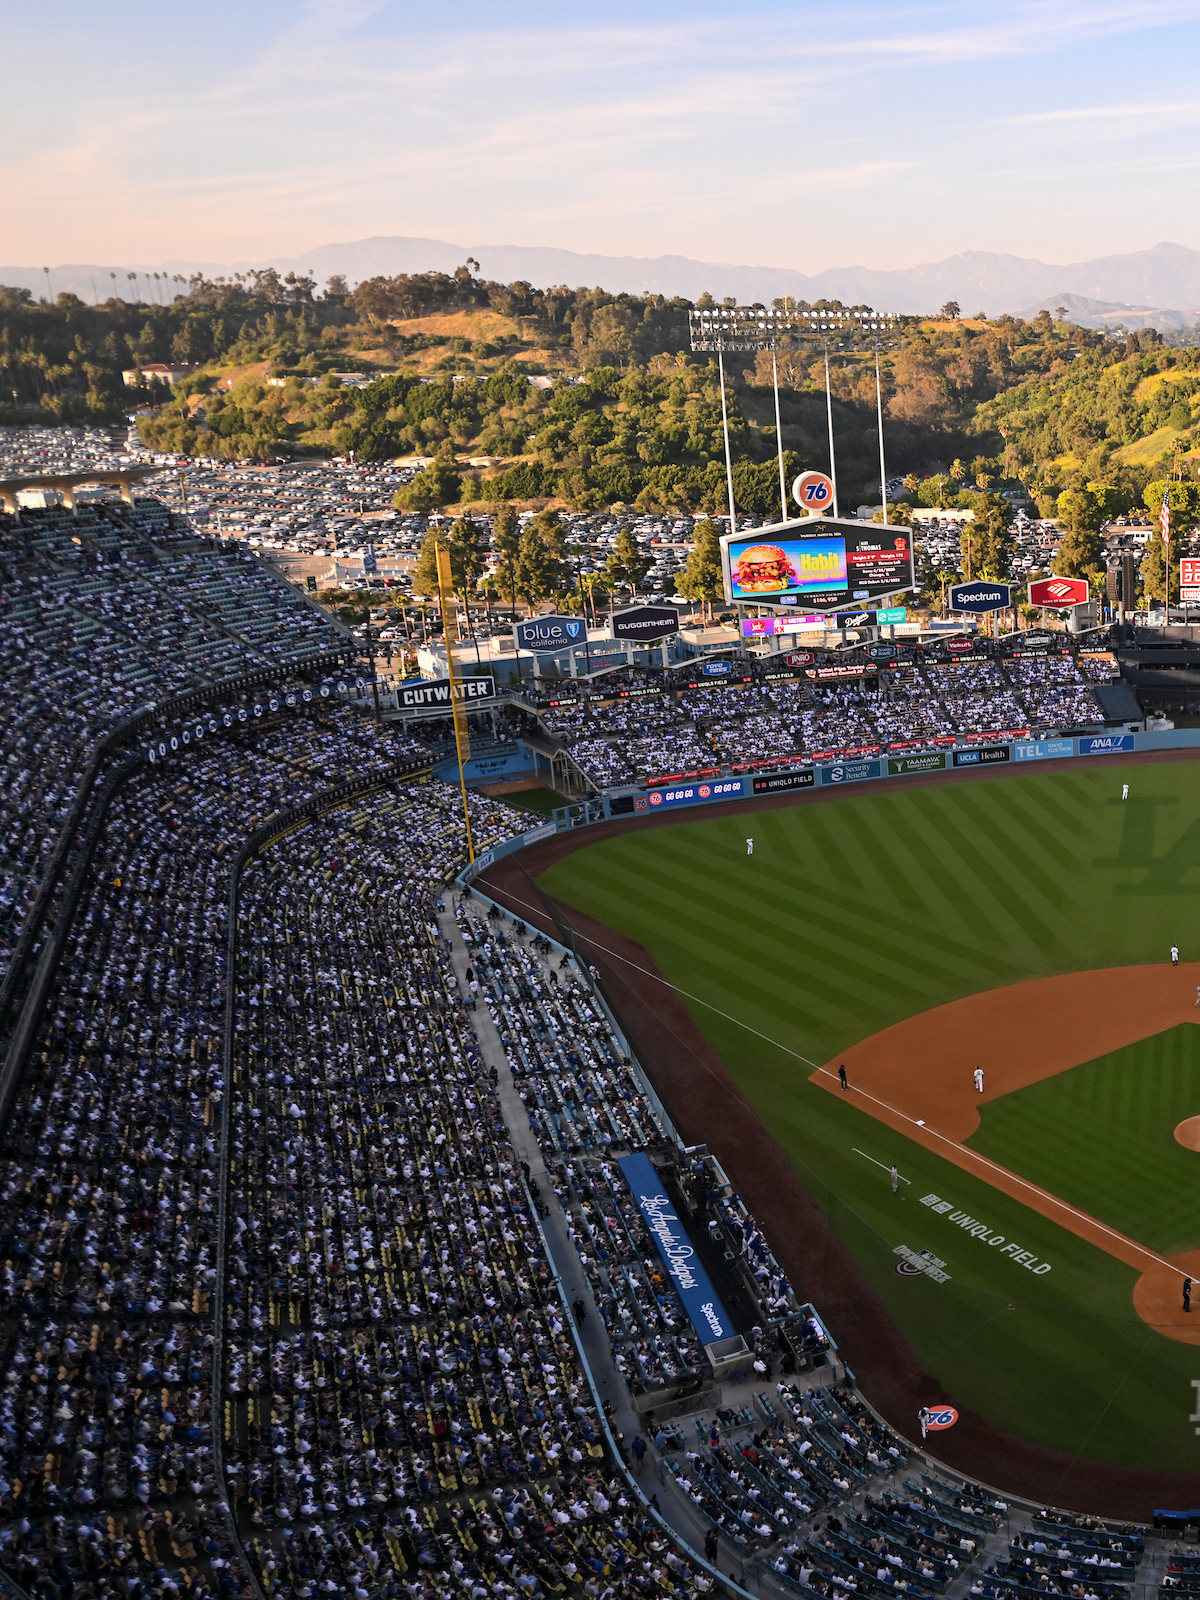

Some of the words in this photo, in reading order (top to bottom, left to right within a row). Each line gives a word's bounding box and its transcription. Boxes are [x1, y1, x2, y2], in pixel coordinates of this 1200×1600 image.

[804, 481, 828, 501] 76
[801, 552, 839, 572] Habit
[957, 592, 1000, 604] Spectrum
[618, 618, 674, 630] GUGGENHEIM
[845, 612, 869, 627] Dodgers
[523, 625, 562, 640] blue
[531, 638, 568, 648] california
[949, 641, 972, 650] Yakult
[792, 654, 810, 662] JINRO
[403, 681, 488, 705] CUTWATER
[1090, 738, 1112, 748] ANA
[981, 750, 1005, 760] Health
[1018, 745, 1043, 758] TEL
[845, 764, 870, 772] Security
[768, 778, 792, 788] UNIQLO
[794, 776, 812, 784] FIELD
[666, 792, 674, 800] GO
[675, 791, 683, 800] GO
[685, 790, 693, 798] GO
[714, 785, 722, 793] GO
[723, 784, 731, 792] GO
[636, 800, 647, 808] 76
[948, 1210, 1006, 1247] UNIQLO
[1000, 1243, 1052, 1275] FIELD
[648, 1212, 678, 1249] Angeles
[667, 1244, 698, 1290] Dodgers
[892, 1244, 932, 1272] OPENING
[924, 1265, 952, 1284] WEEK
[701, 1302, 724, 1337] Spectrum
[927, 1409, 955, 1426] 76
